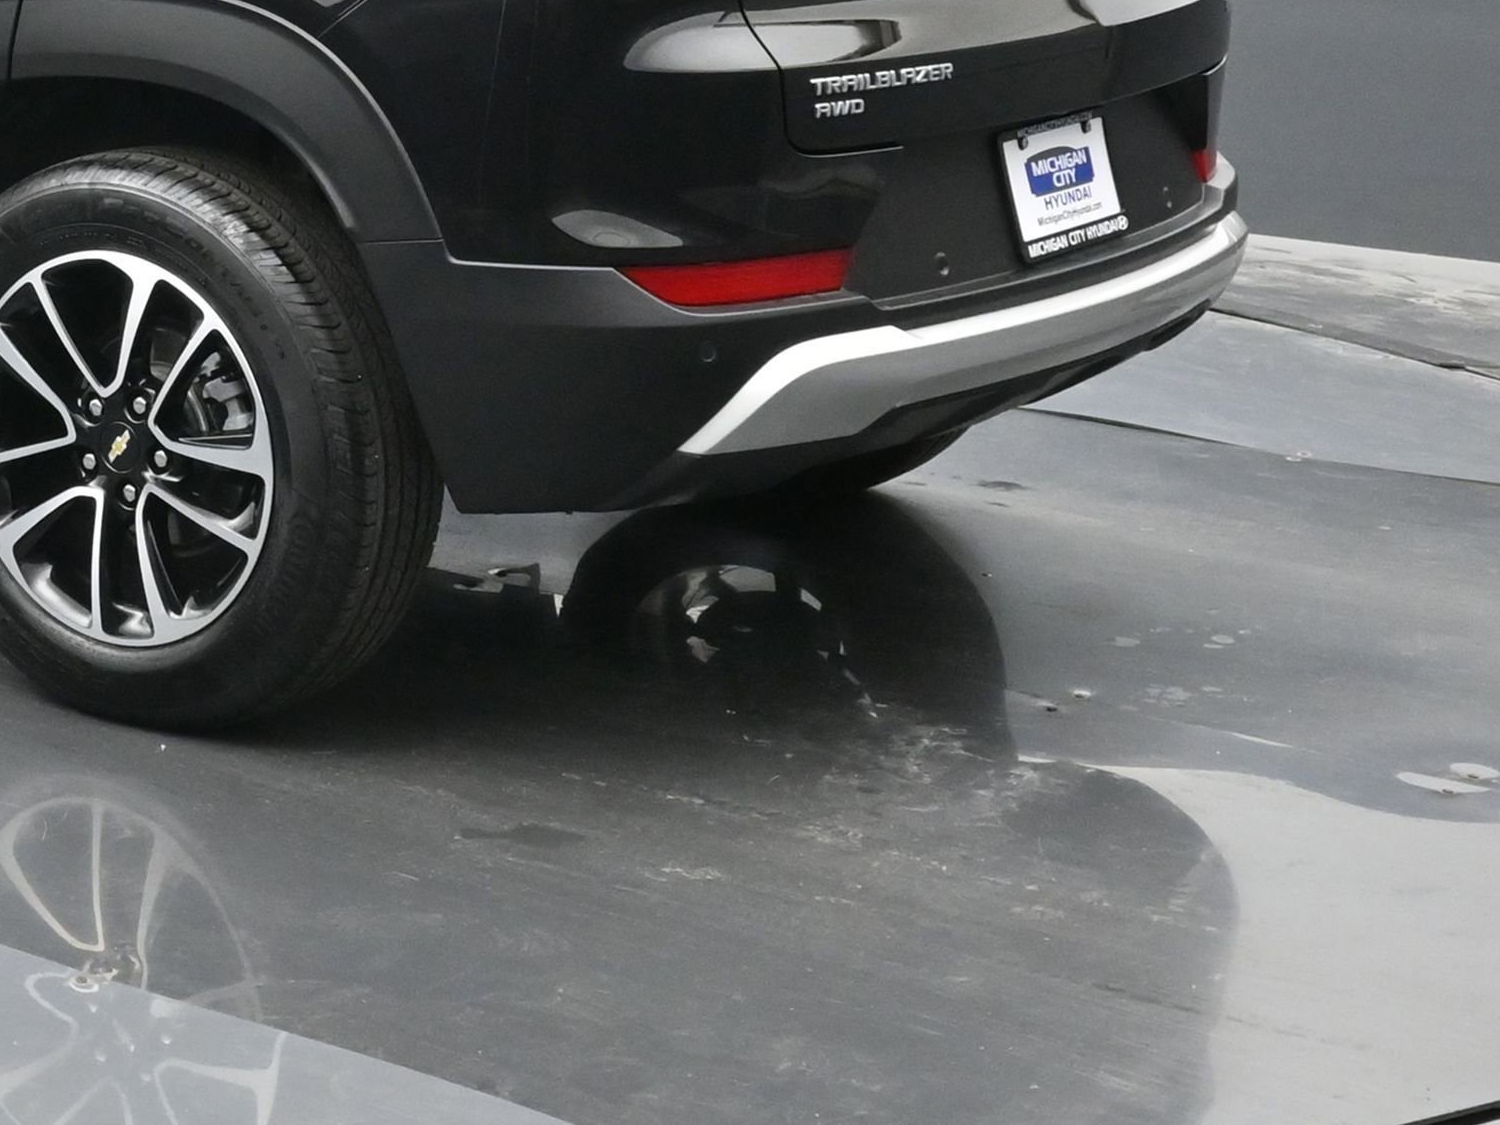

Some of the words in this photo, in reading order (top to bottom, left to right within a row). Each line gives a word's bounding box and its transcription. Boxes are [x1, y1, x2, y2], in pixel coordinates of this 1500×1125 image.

[810, 62, 954, 96] TRAILBLAZER
[814, 98, 865, 119] AWD
[1030, 149, 1087, 177] MICHIGAN
[1052, 168, 1077, 188] CITY
[1043, 186, 1093, 211] HYUNDAI
[1028, 234, 1069, 258] MICHIGAN
[1068, 228, 1087, 245] CITY
[1086, 217, 1119, 240] HYUNDAI
